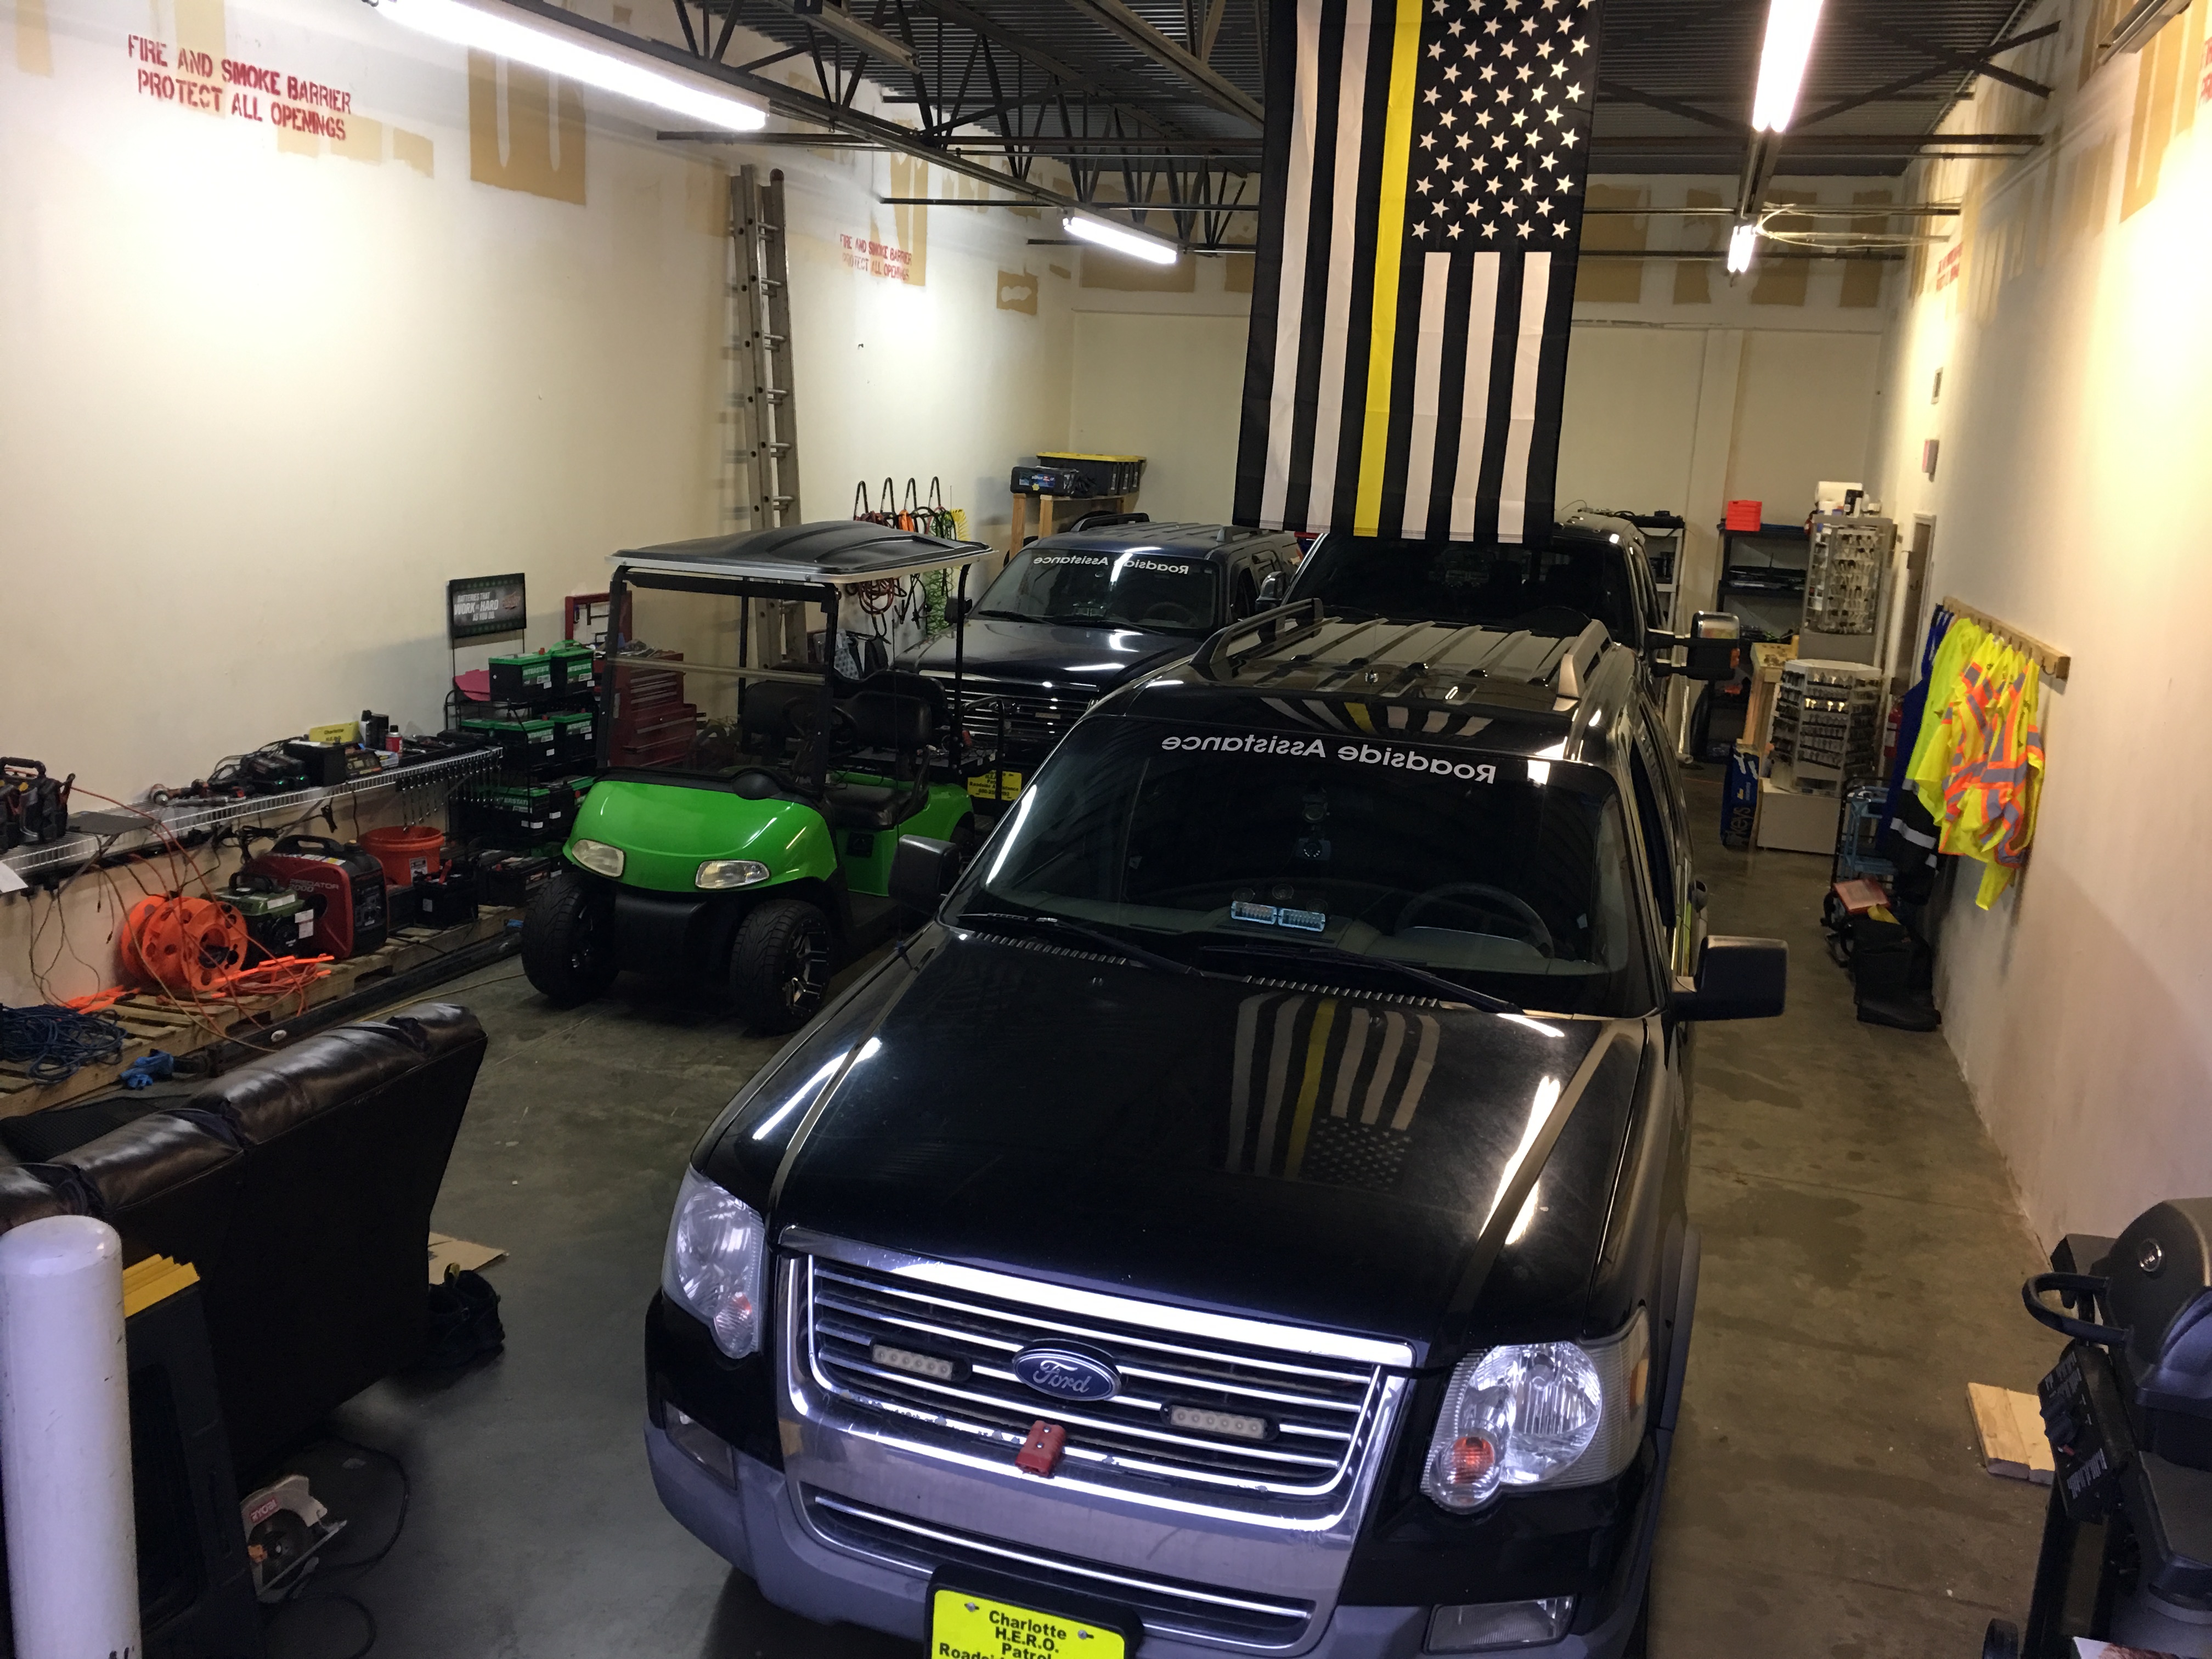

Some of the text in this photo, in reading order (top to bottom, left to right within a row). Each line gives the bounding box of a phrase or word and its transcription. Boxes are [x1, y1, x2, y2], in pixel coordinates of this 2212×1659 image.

[128, 34, 351, 114] FIRE AND SMOKE BARRIER
[138, 69, 346, 140] PROTECT ALL OPENINGS
[840, 234, 912, 266] FIRE AND SMOKE BARRIER
[842, 252, 910, 281] PROTECT ALL OPENINGS
[454, 602, 475, 616] WORK
[480, 600, 499, 612] HARD
[290, 878, 339, 891] PREDATOR
[1032, 1360, 1092, 1393] Ford
[250, 1499, 277, 1522] RYOBI
[989, 1610, 1066, 1640] Charlotte
[995, 1627, 1059, 1653] H.E.R.O.
